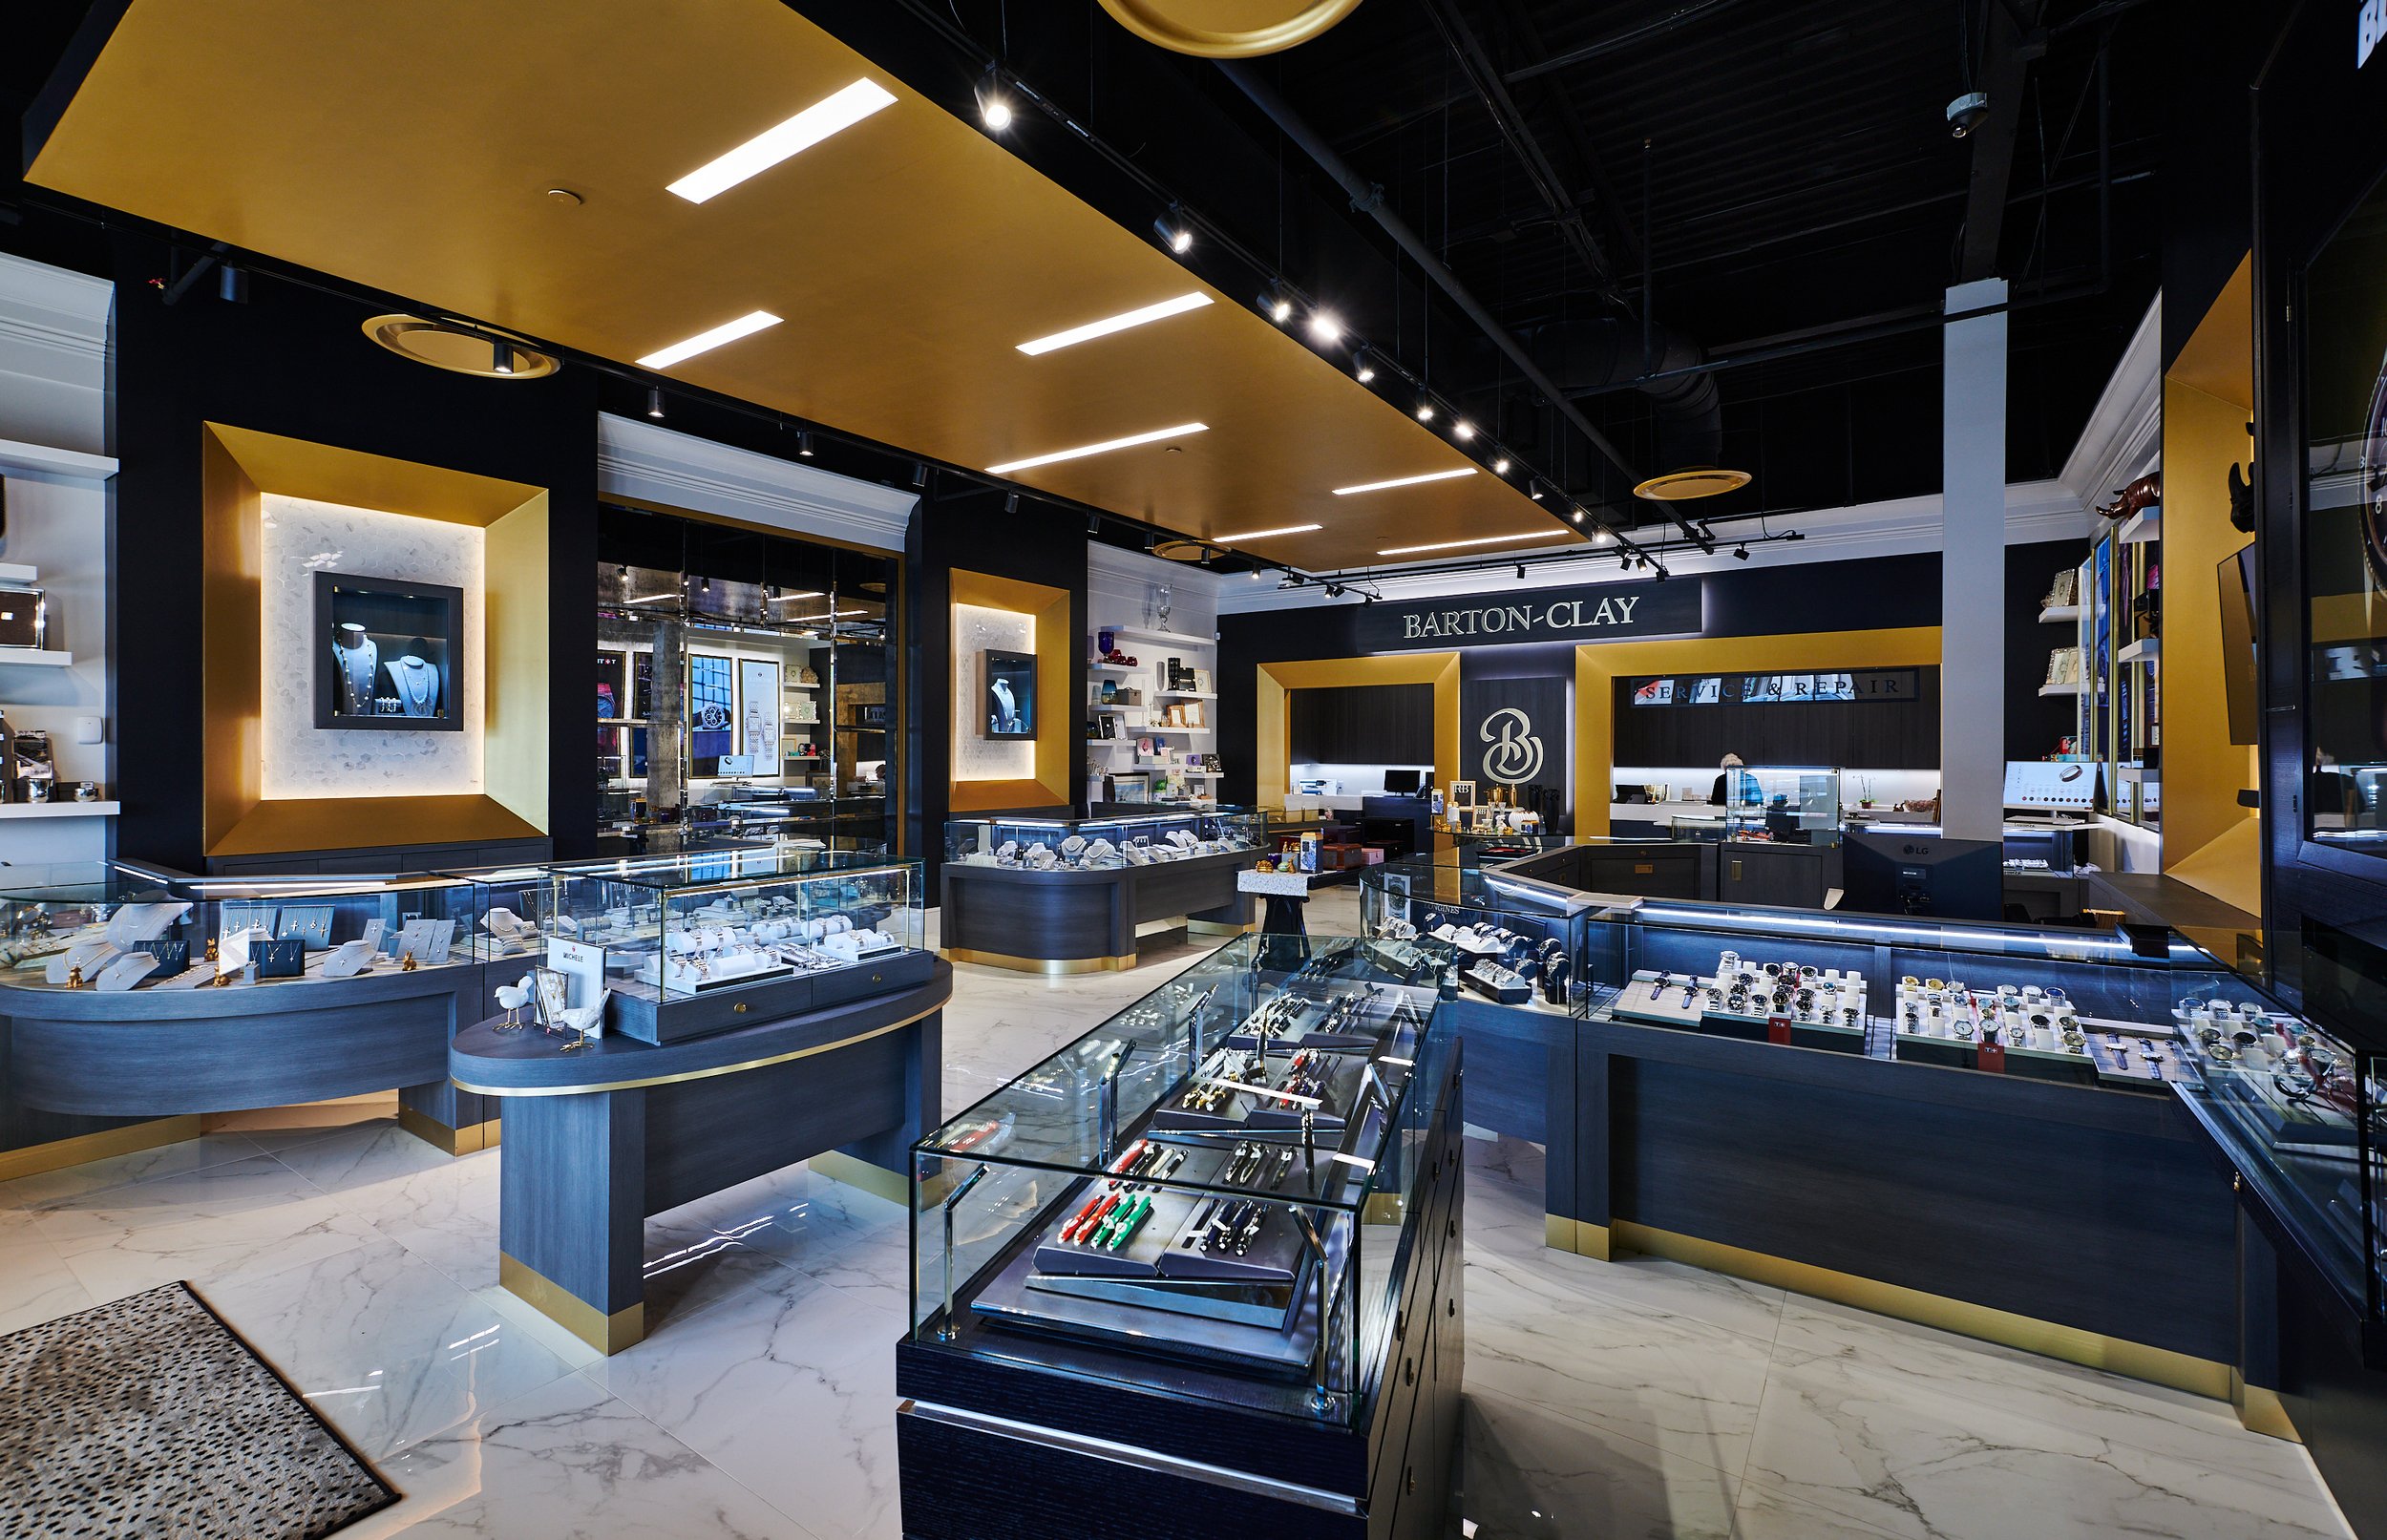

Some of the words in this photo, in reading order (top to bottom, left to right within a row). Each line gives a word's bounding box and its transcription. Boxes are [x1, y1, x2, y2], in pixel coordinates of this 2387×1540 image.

[1404, 597, 1639, 638] BARTON-CLAY
[1645, 684, 1752, 700] SERVICE
[1767, 682, 1782, 695] &
[1795, 679, 1900, 696] REPAIR
[1424, 903, 1460, 915] LONGINES
[563, 952, 584, 962] MICHELE
